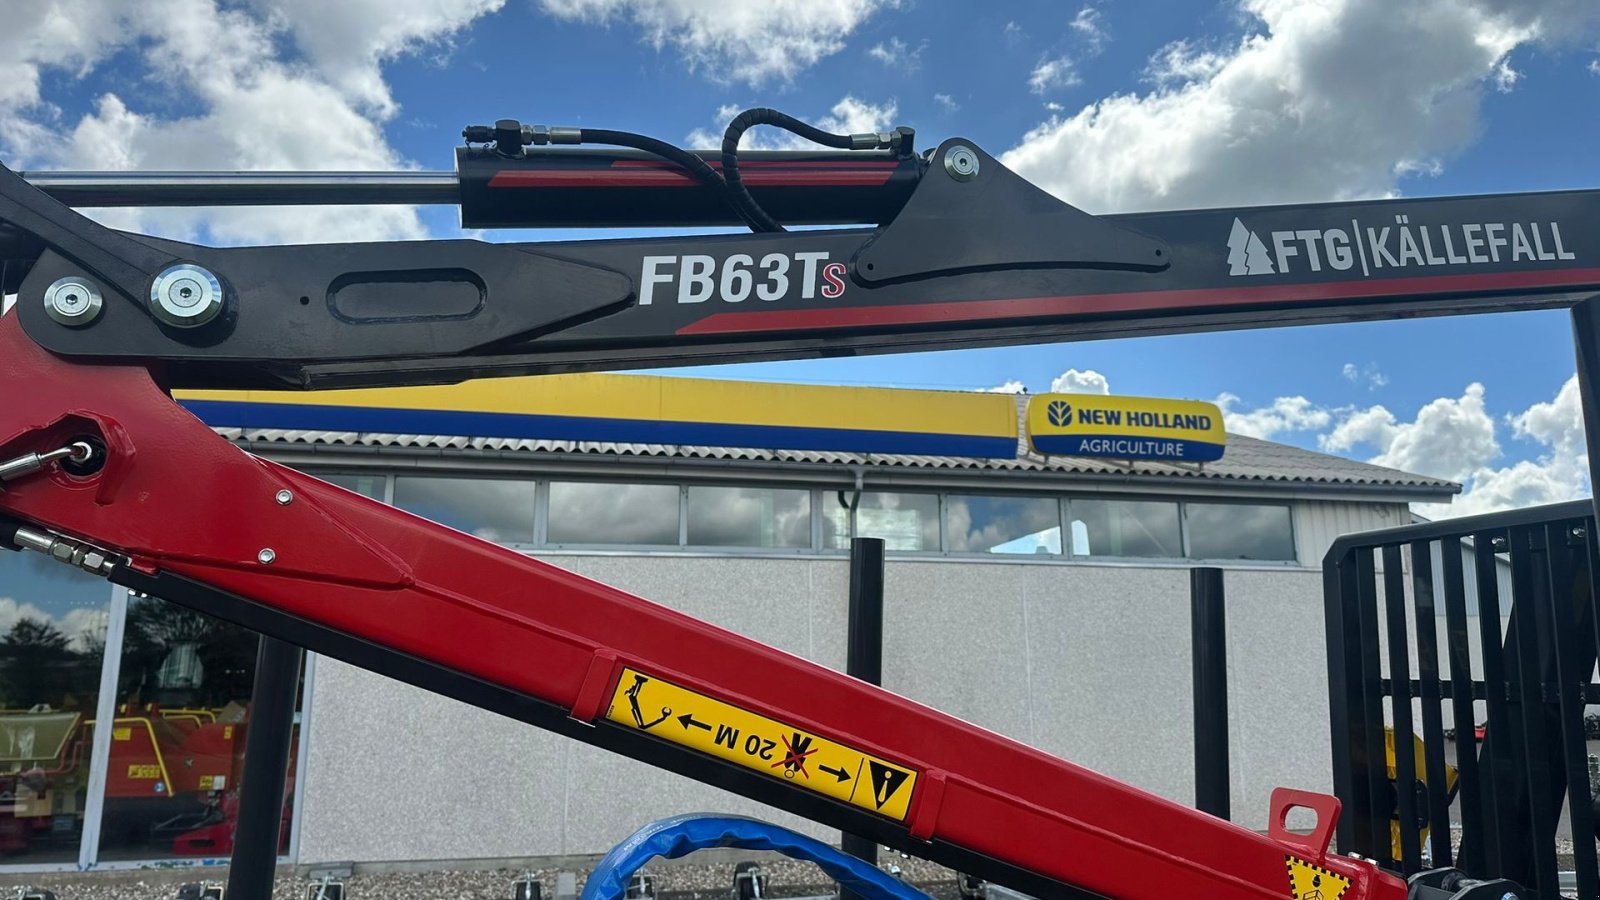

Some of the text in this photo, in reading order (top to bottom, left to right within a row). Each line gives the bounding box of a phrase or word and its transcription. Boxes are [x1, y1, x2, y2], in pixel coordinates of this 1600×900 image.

[1078, 408, 1211, 431] NEW HOLLAND
[1079, 439, 1184, 457] AGRICULTURE
[714, 723, 777, 761] 20 M
